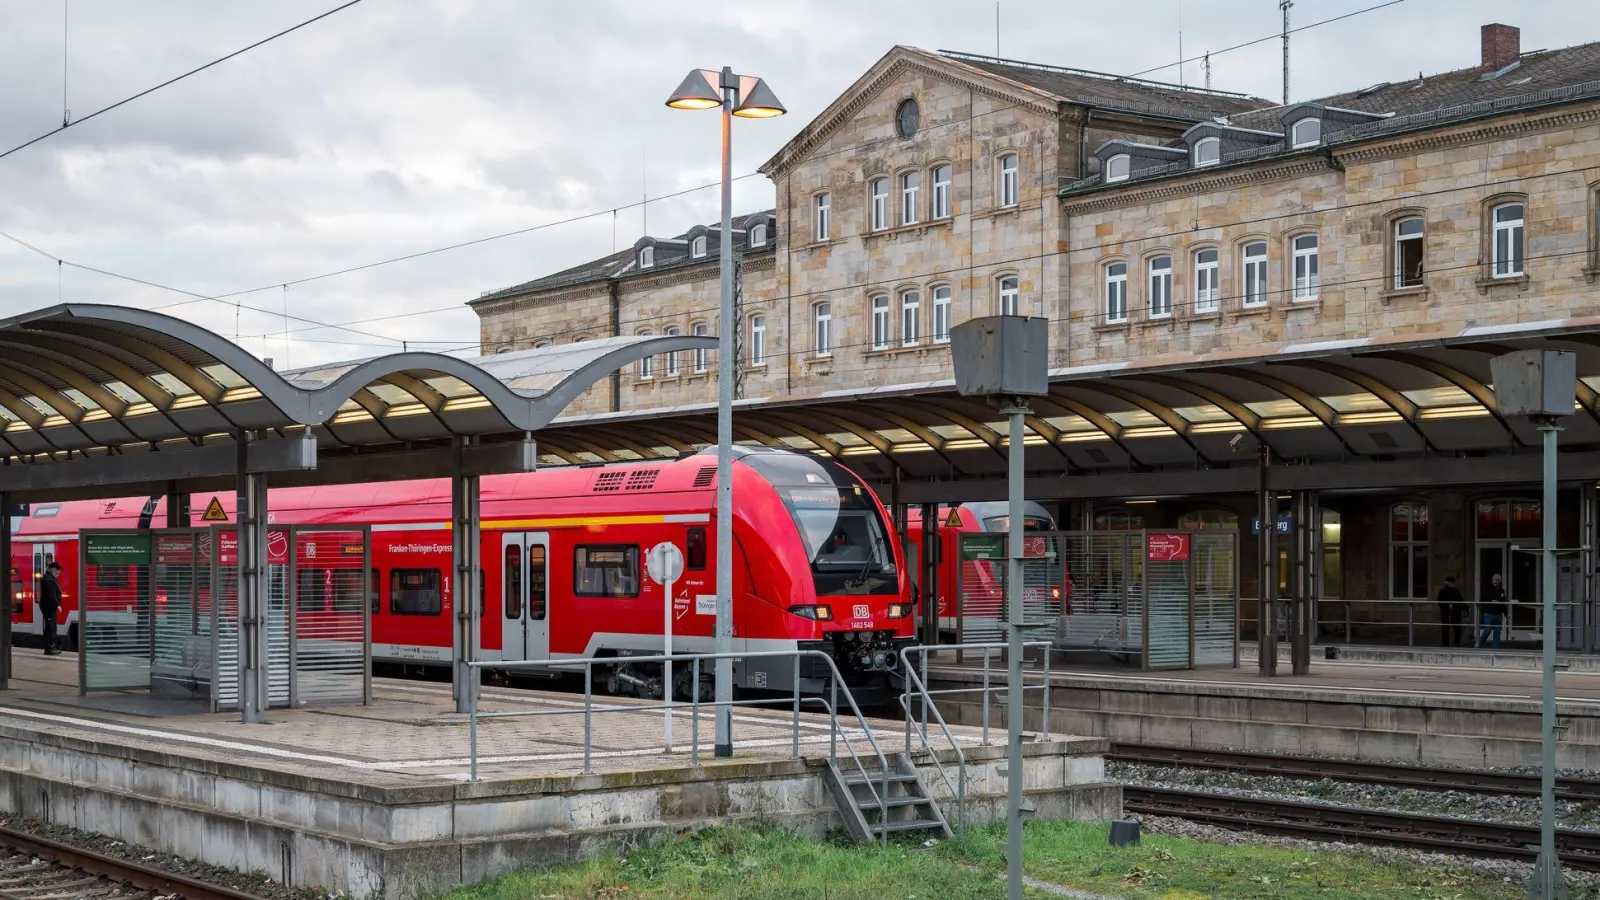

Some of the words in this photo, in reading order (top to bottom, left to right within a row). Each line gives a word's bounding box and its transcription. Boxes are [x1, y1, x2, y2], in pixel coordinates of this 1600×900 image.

[388, 543, 453, 554] Franken-Thüringen-Express
[444, 576, 450, 593] 1
[855, 607, 867, 616] DB
